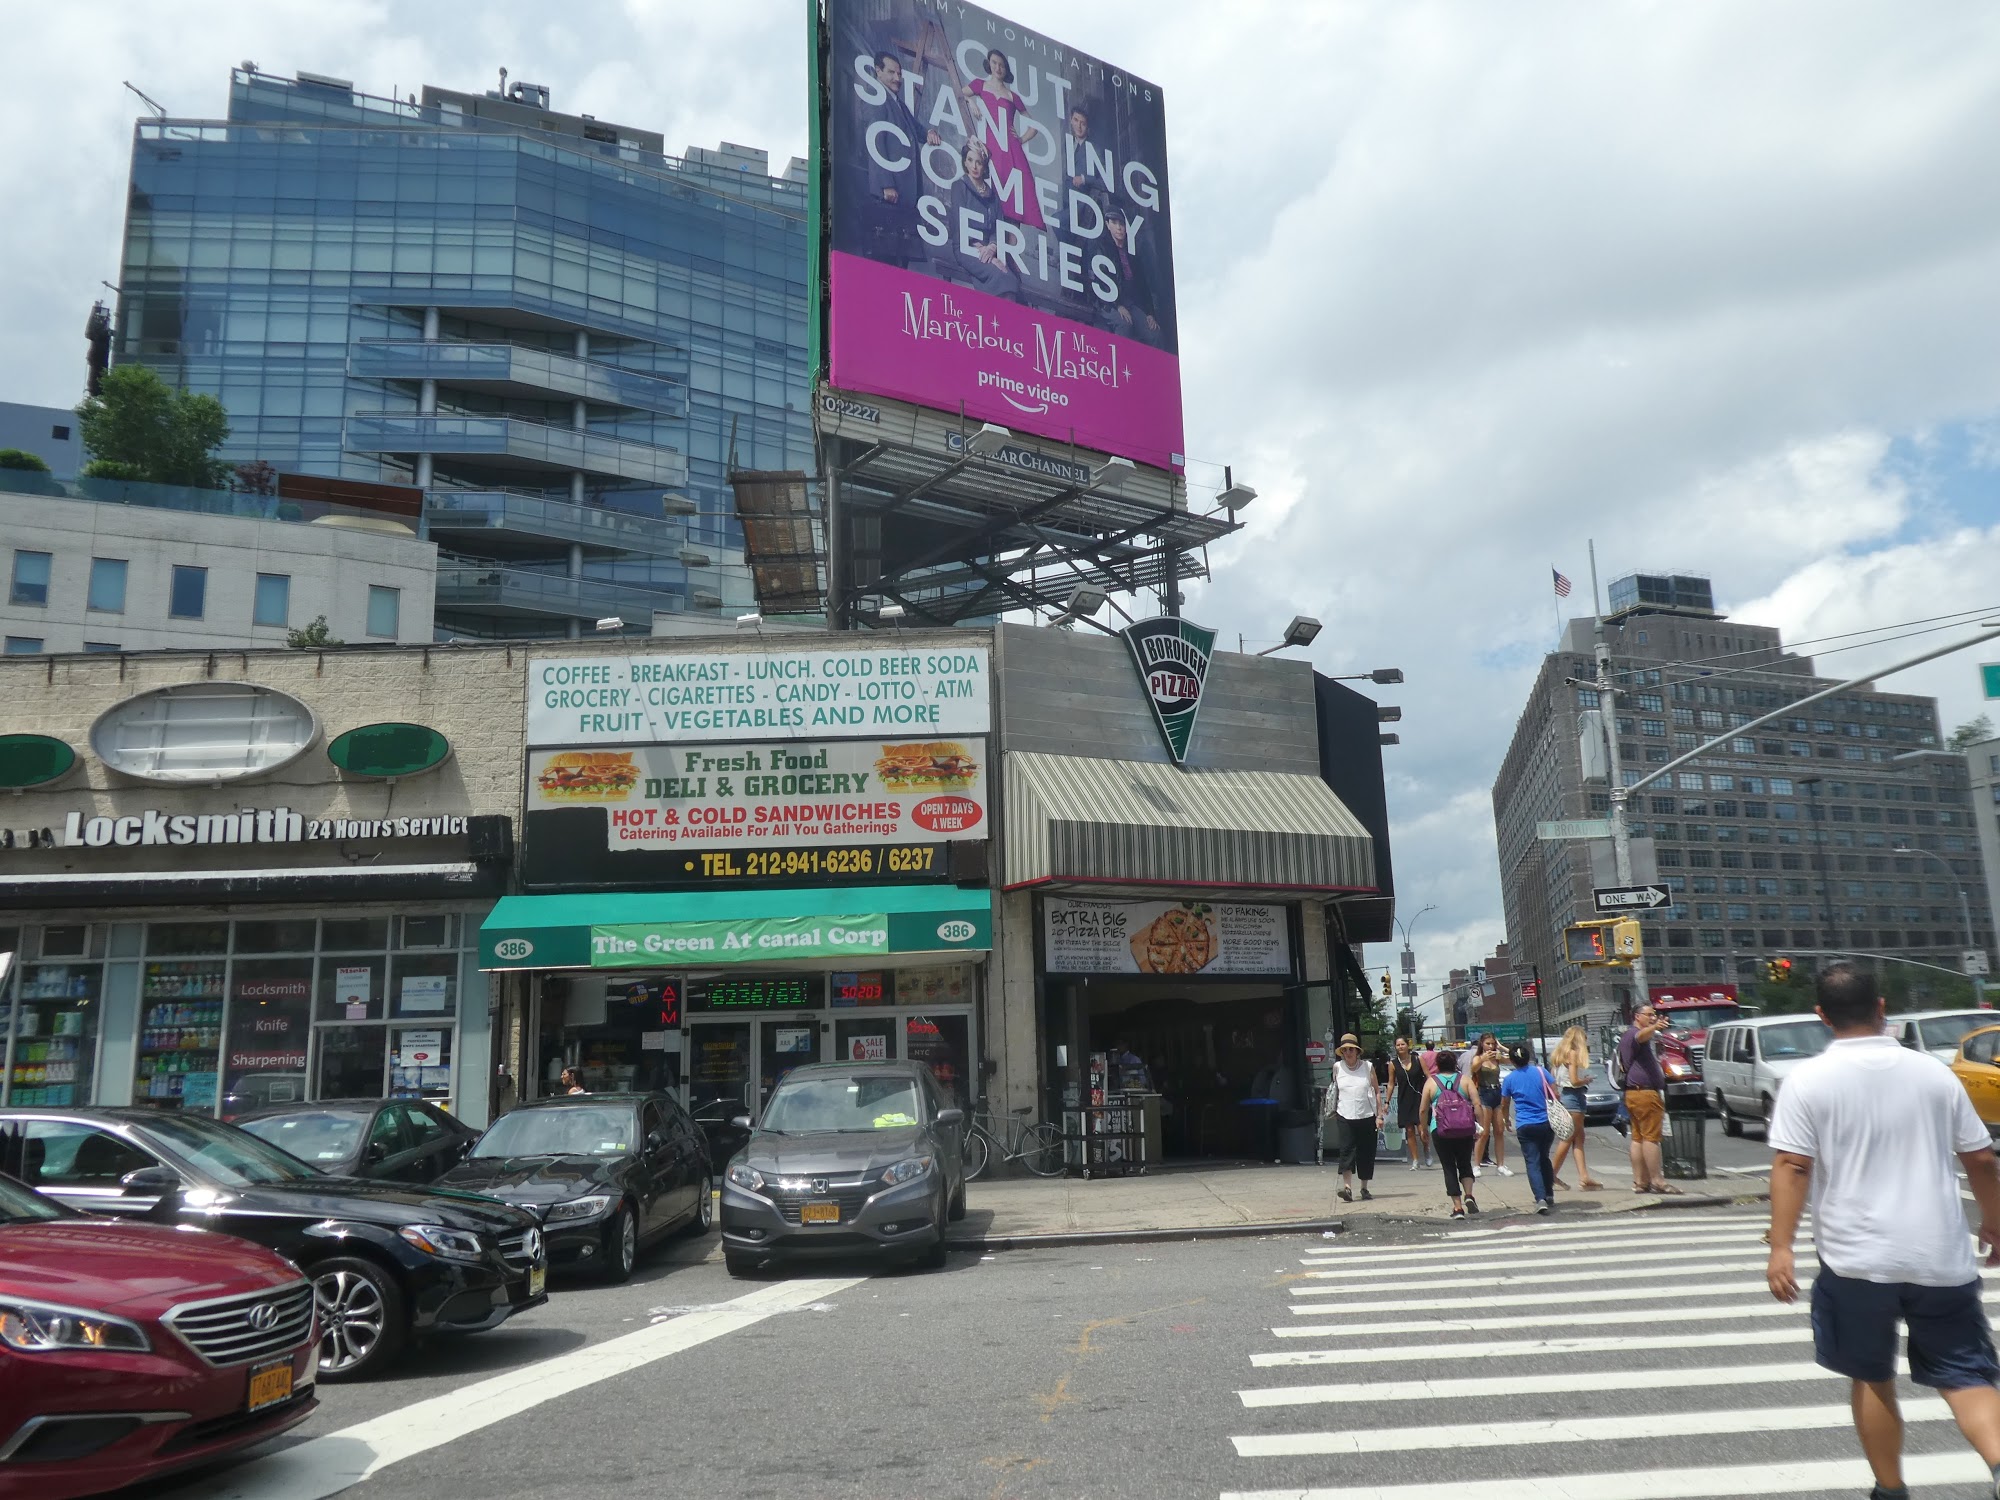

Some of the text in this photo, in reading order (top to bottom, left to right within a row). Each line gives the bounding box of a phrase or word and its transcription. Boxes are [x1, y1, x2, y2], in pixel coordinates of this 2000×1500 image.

[916, 0, 1152, 103] MY NOMINATIONS
[955, 39, 1071, 119] OUT
[853, 54, 1160, 213] STANDING
[865, 121, 1145, 256] COMEDY
[916, 195, 1120, 302] SERIES
[941, 293, 963, 319] The
[901, 292, 1024, 359] Marvelous
[1032, 323, 1119, 388] Maisel
[1072, 331, 1099, 355] Mrs.
[978, 370, 1069, 407] prime video
[825, 397, 879, 422] 022227
[543, 666, 610, 685] COFFEE
[631, 663, 729, 683] BREAKFAST
[822, 659, 872, 678] COLD
[880, 657, 920, 676] BEER
[927, 656, 979, 674] SODA
[1145, 637, 1207, 684] BOROUGH
[545, 688, 630, 708] GROCERY
[648, 685, 755, 706] CIGARETTES
[776, 683, 839, 702] CANDY
[858, 681, 915, 701] LOTTO
[935, 679, 973, 698] ATM
[1151, 674, 1199, 699] PIZZA
[580, 713, 643, 732] FRUIT
[666, 707, 804, 728] VEGETABLES
[812, 706, 865, 725] AND
[873, 704, 940, 724] MORE
[685, 748, 828, 772] Fresh Food
[645, 772, 869, 799] DELI & GROCERY
[612, 802, 901, 826] HOT & COLD SANDWICHES
[921, 801, 974, 815] OPEN 7 DAYS
[64, 807, 305, 847] Locksmith
[308, 820, 331, 839] 24
[336, 819, 392, 838] Hours
[619, 820, 898, 841] Catering Available For All You Gatherings
[932, 817, 963, 829] A WEEK
[701, 853, 740, 876] TEL.
[747, 849, 872, 874] 212-941-6236
[889, 848, 934, 870] 6237
[1605, 892, 1658, 904] ONE WAY
[1052, 911, 1127, 926] EXTRA BIG
[1221, 907, 1269, 917] NO FAKING!
[593, 927, 887, 953] The Green At canal Corp
[943, 923, 969, 939] 386
[1068, 926, 1100, 937] PIZZA
[1102, 927, 1126, 938] PIES
[500, 942, 527, 957] 386
[242, 983, 305, 995] Locksmith
[858, 986, 882, 998] 203
[662, 986, 676, 1023] ATM
[256, 1020, 288, 1031] Knife
[866, 1038, 883, 1046] SALE
[866, 1049, 883, 1058] SALE
[232, 1054, 305, 1067] Sharpening
